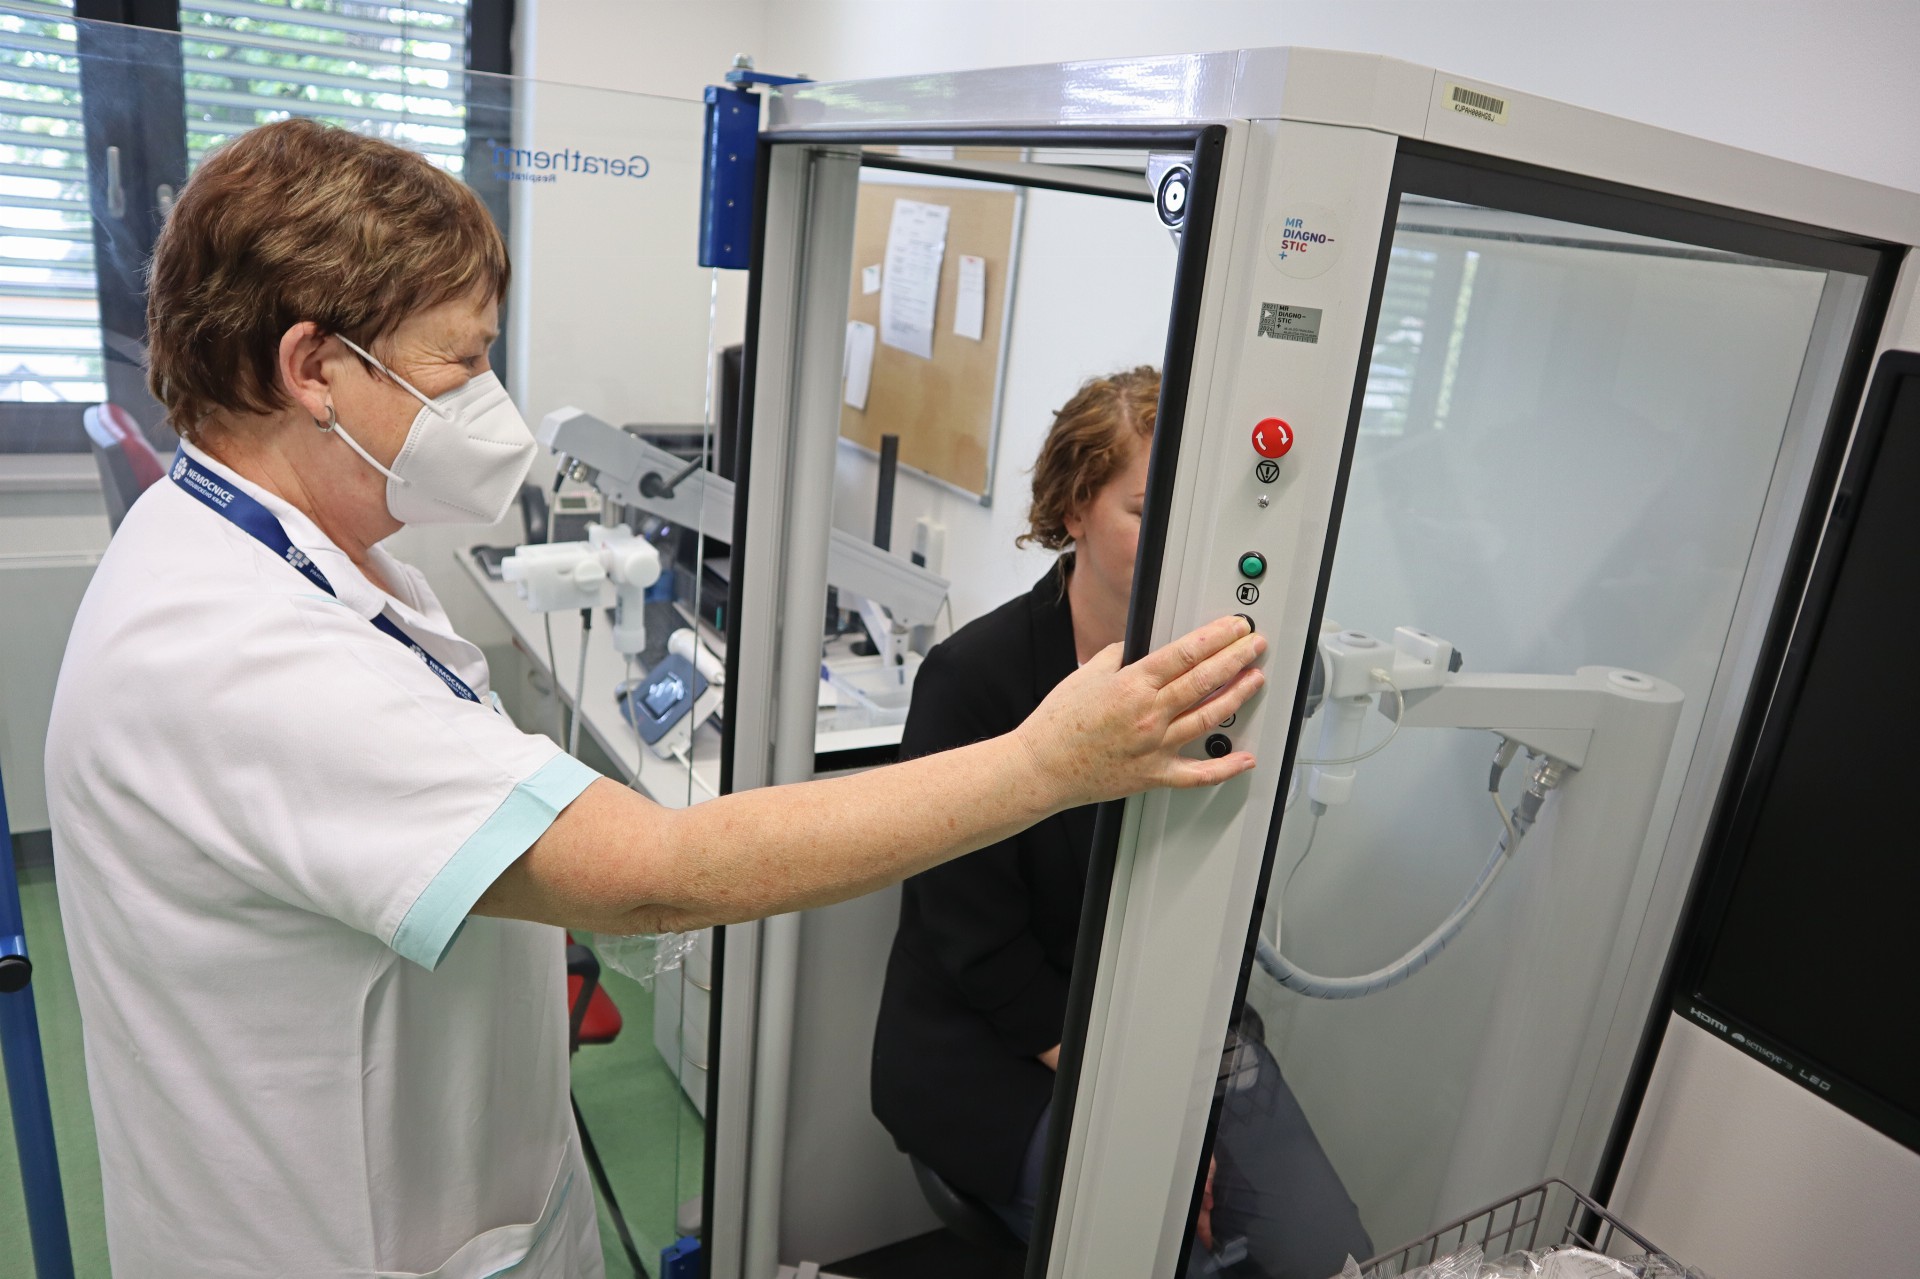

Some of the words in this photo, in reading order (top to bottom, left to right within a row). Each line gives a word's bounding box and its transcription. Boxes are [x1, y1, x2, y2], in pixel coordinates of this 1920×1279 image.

[1285, 217, 1303, 228] MR
[1281, 240, 1308, 252] STIC
[186, 468, 235, 503] NEMOCNICE
[429, 660, 473, 699] NEMOCNICE
[1798, 1068, 1831, 1091] LED
